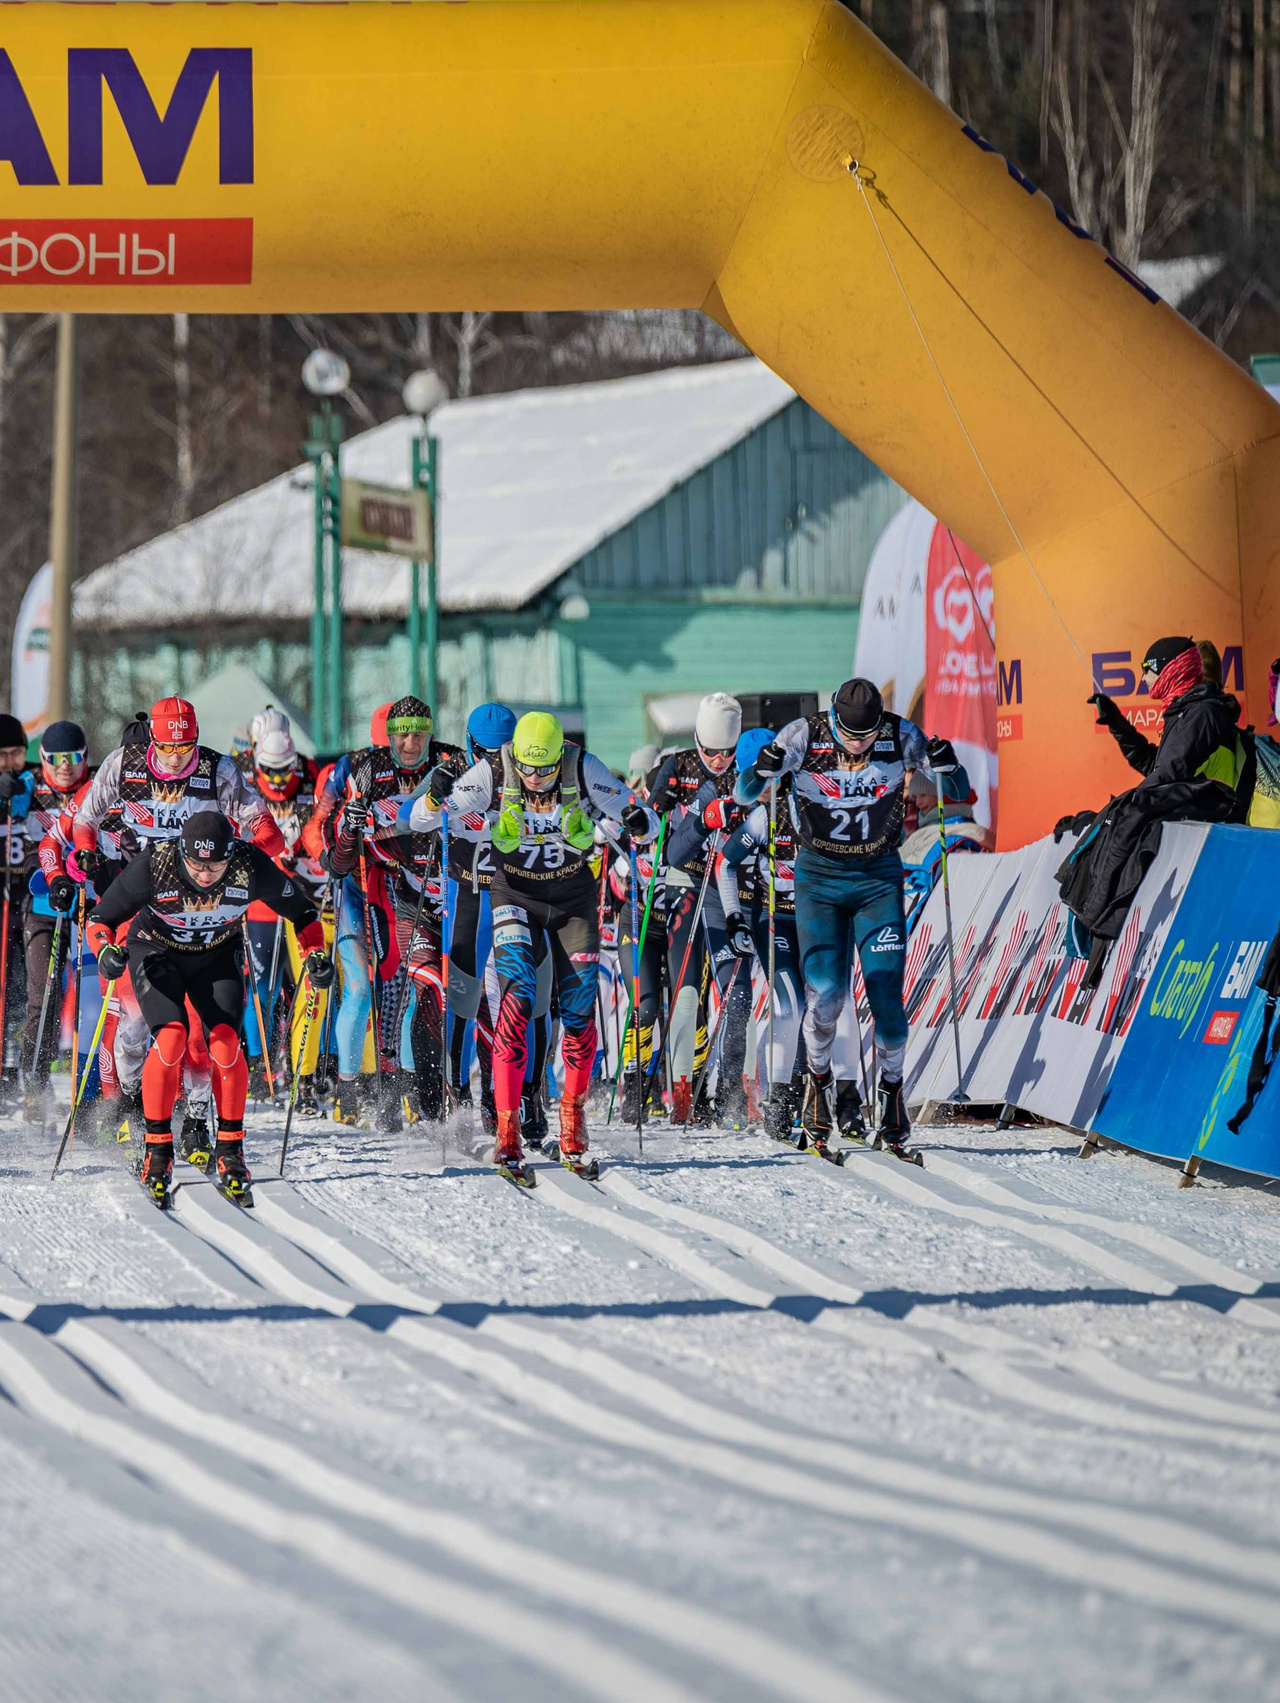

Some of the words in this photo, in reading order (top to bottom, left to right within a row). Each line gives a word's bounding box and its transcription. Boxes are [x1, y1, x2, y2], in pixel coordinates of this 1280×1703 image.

[168, 720, 188, 731] DNB
[845, 776, 888, 786] KRAS
[158, 809, 189, 819] KRA
[158, 817, 184, 828] LAN
[829, 809, 869, 841] 21
[194, 839, 215, 850] DNB
[813, 837, 864, 854] КОРОЛЕВСКИЕ
[518, 843, 565, 869] 75
[504, 863, 556, 880] КОРОЛЕВСКИЕ
[1220, 941, 1268, 998] БАМ
